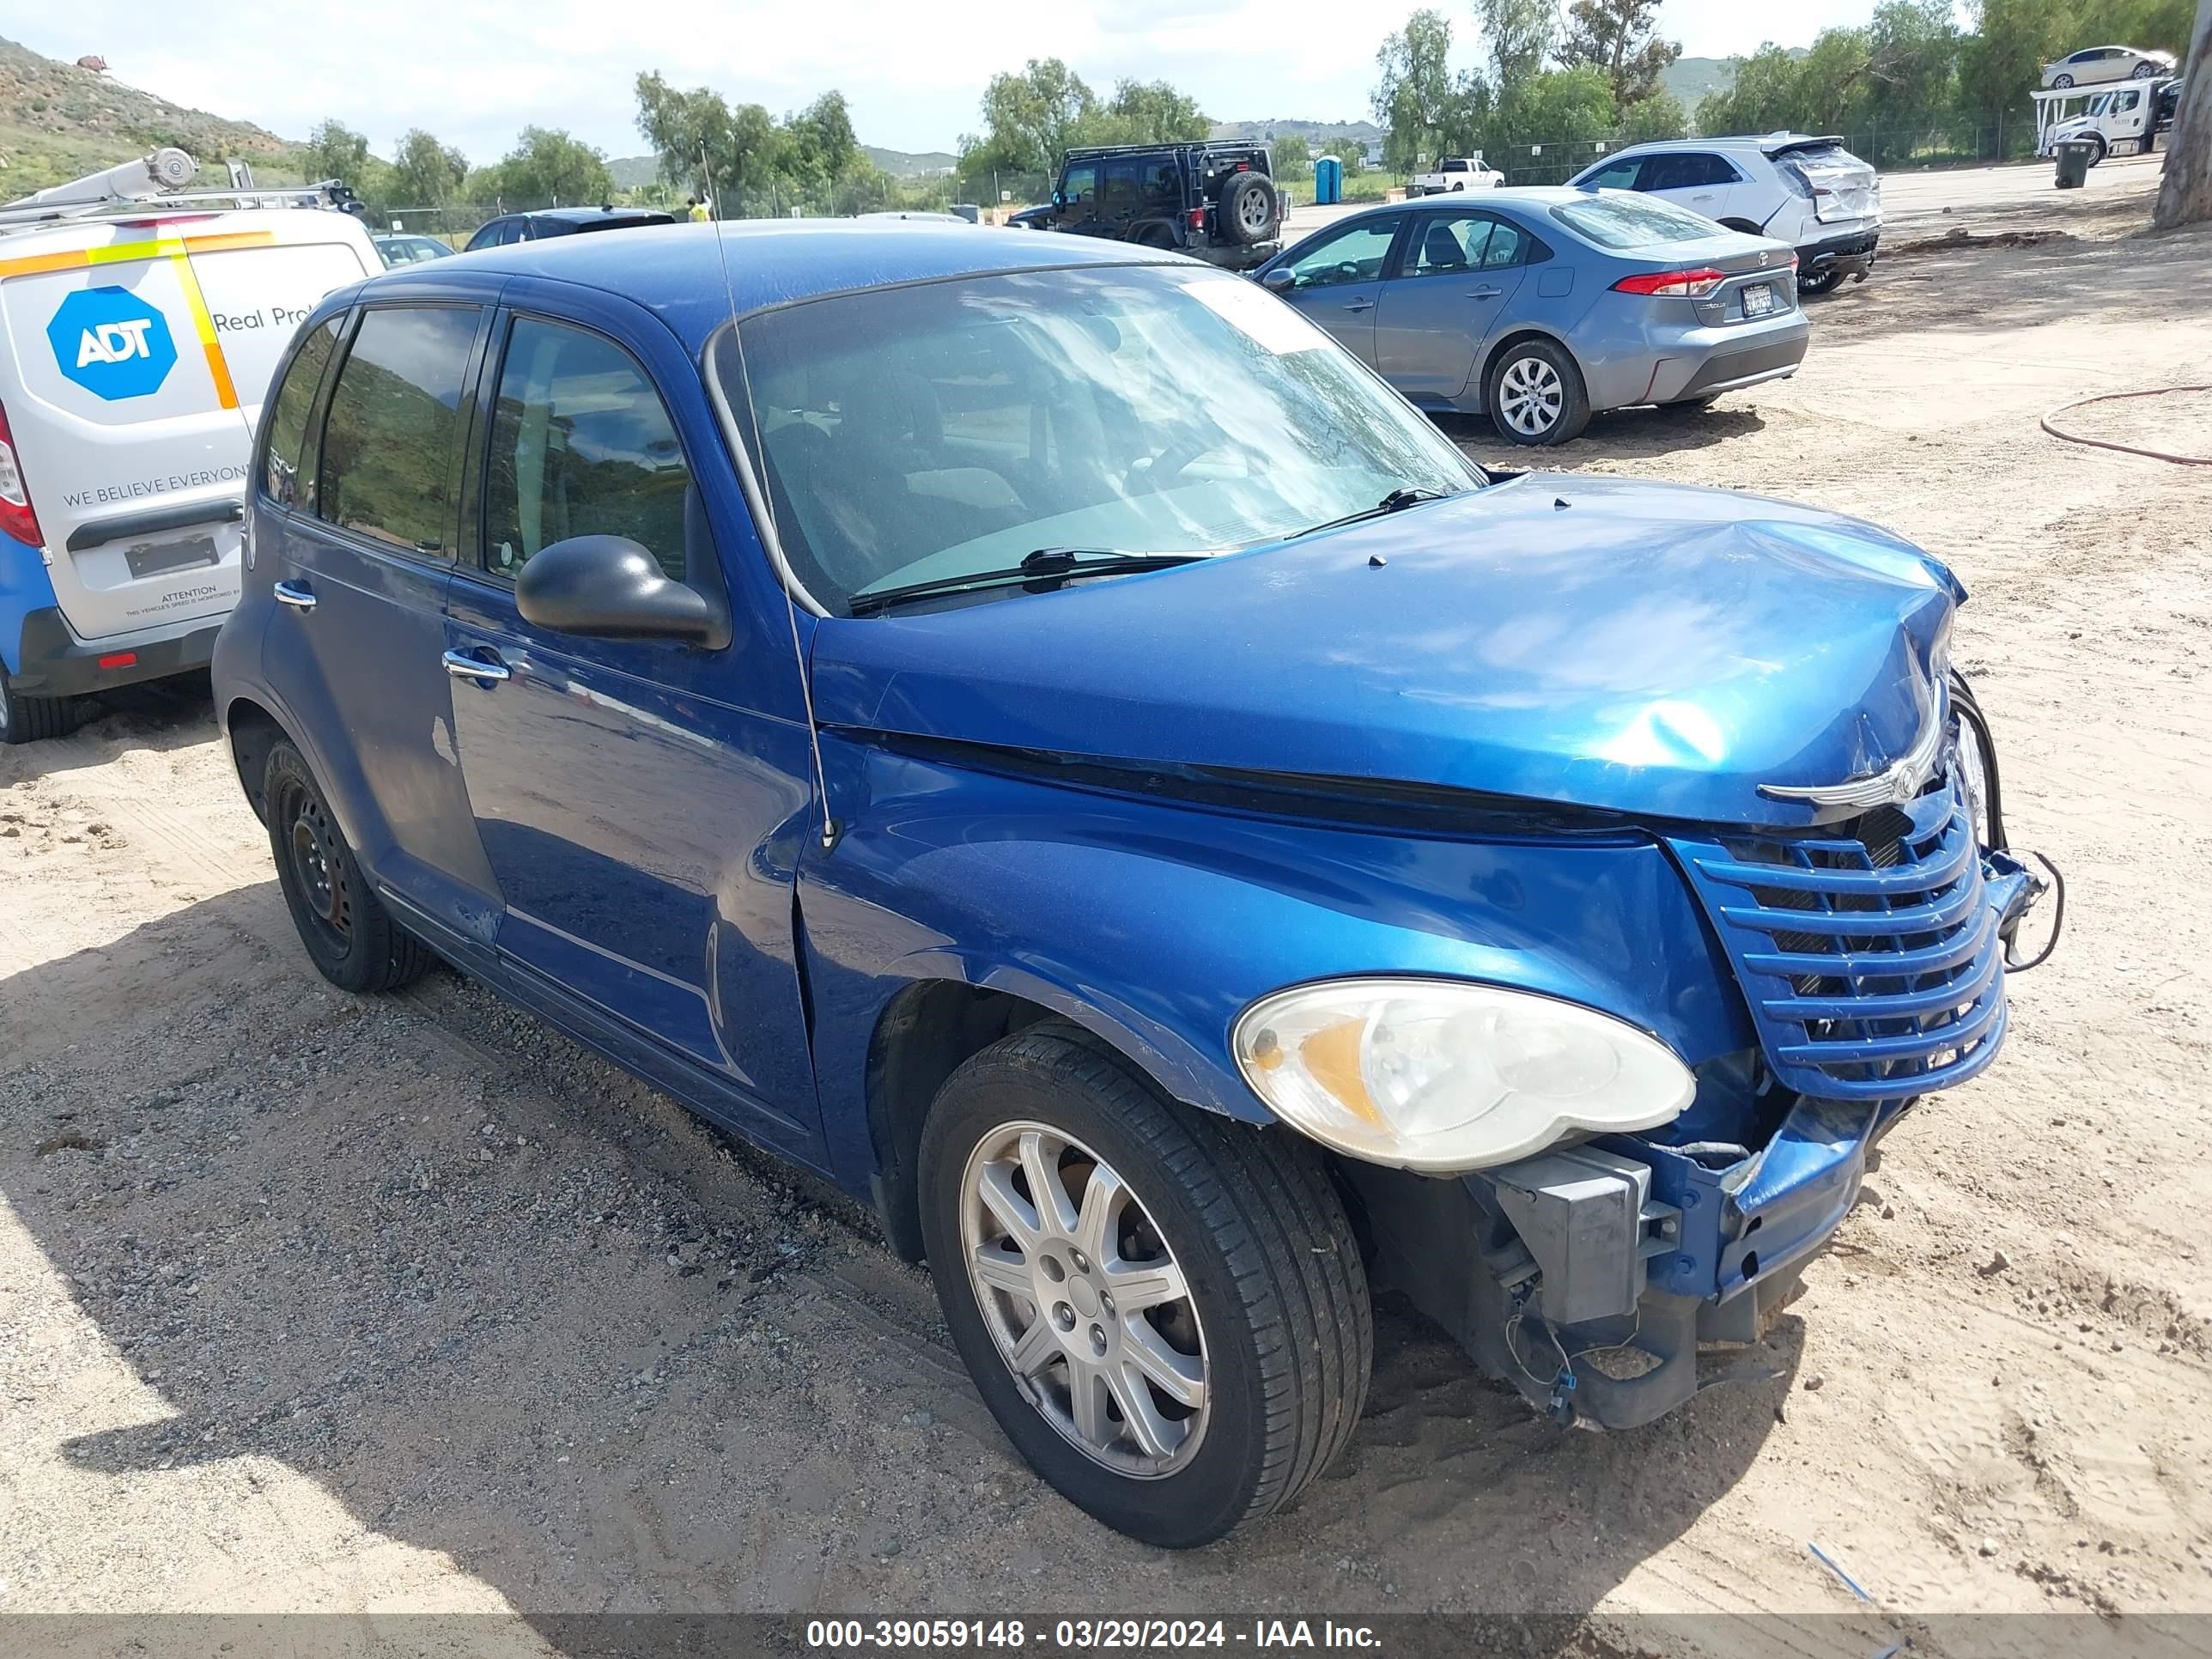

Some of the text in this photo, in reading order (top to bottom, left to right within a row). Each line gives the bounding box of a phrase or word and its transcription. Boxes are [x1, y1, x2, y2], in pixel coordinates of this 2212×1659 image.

[213, 309, 264, 332] Real
[76, 318, 151, 368] ADT
[64, 464, 250, 507] WE BELIEVE EVERYON
[161, 585, 216, 603] ATTENTION
[171, 599, 190, 608] SPEED
[198, 592, 232, 602] MONITORED
